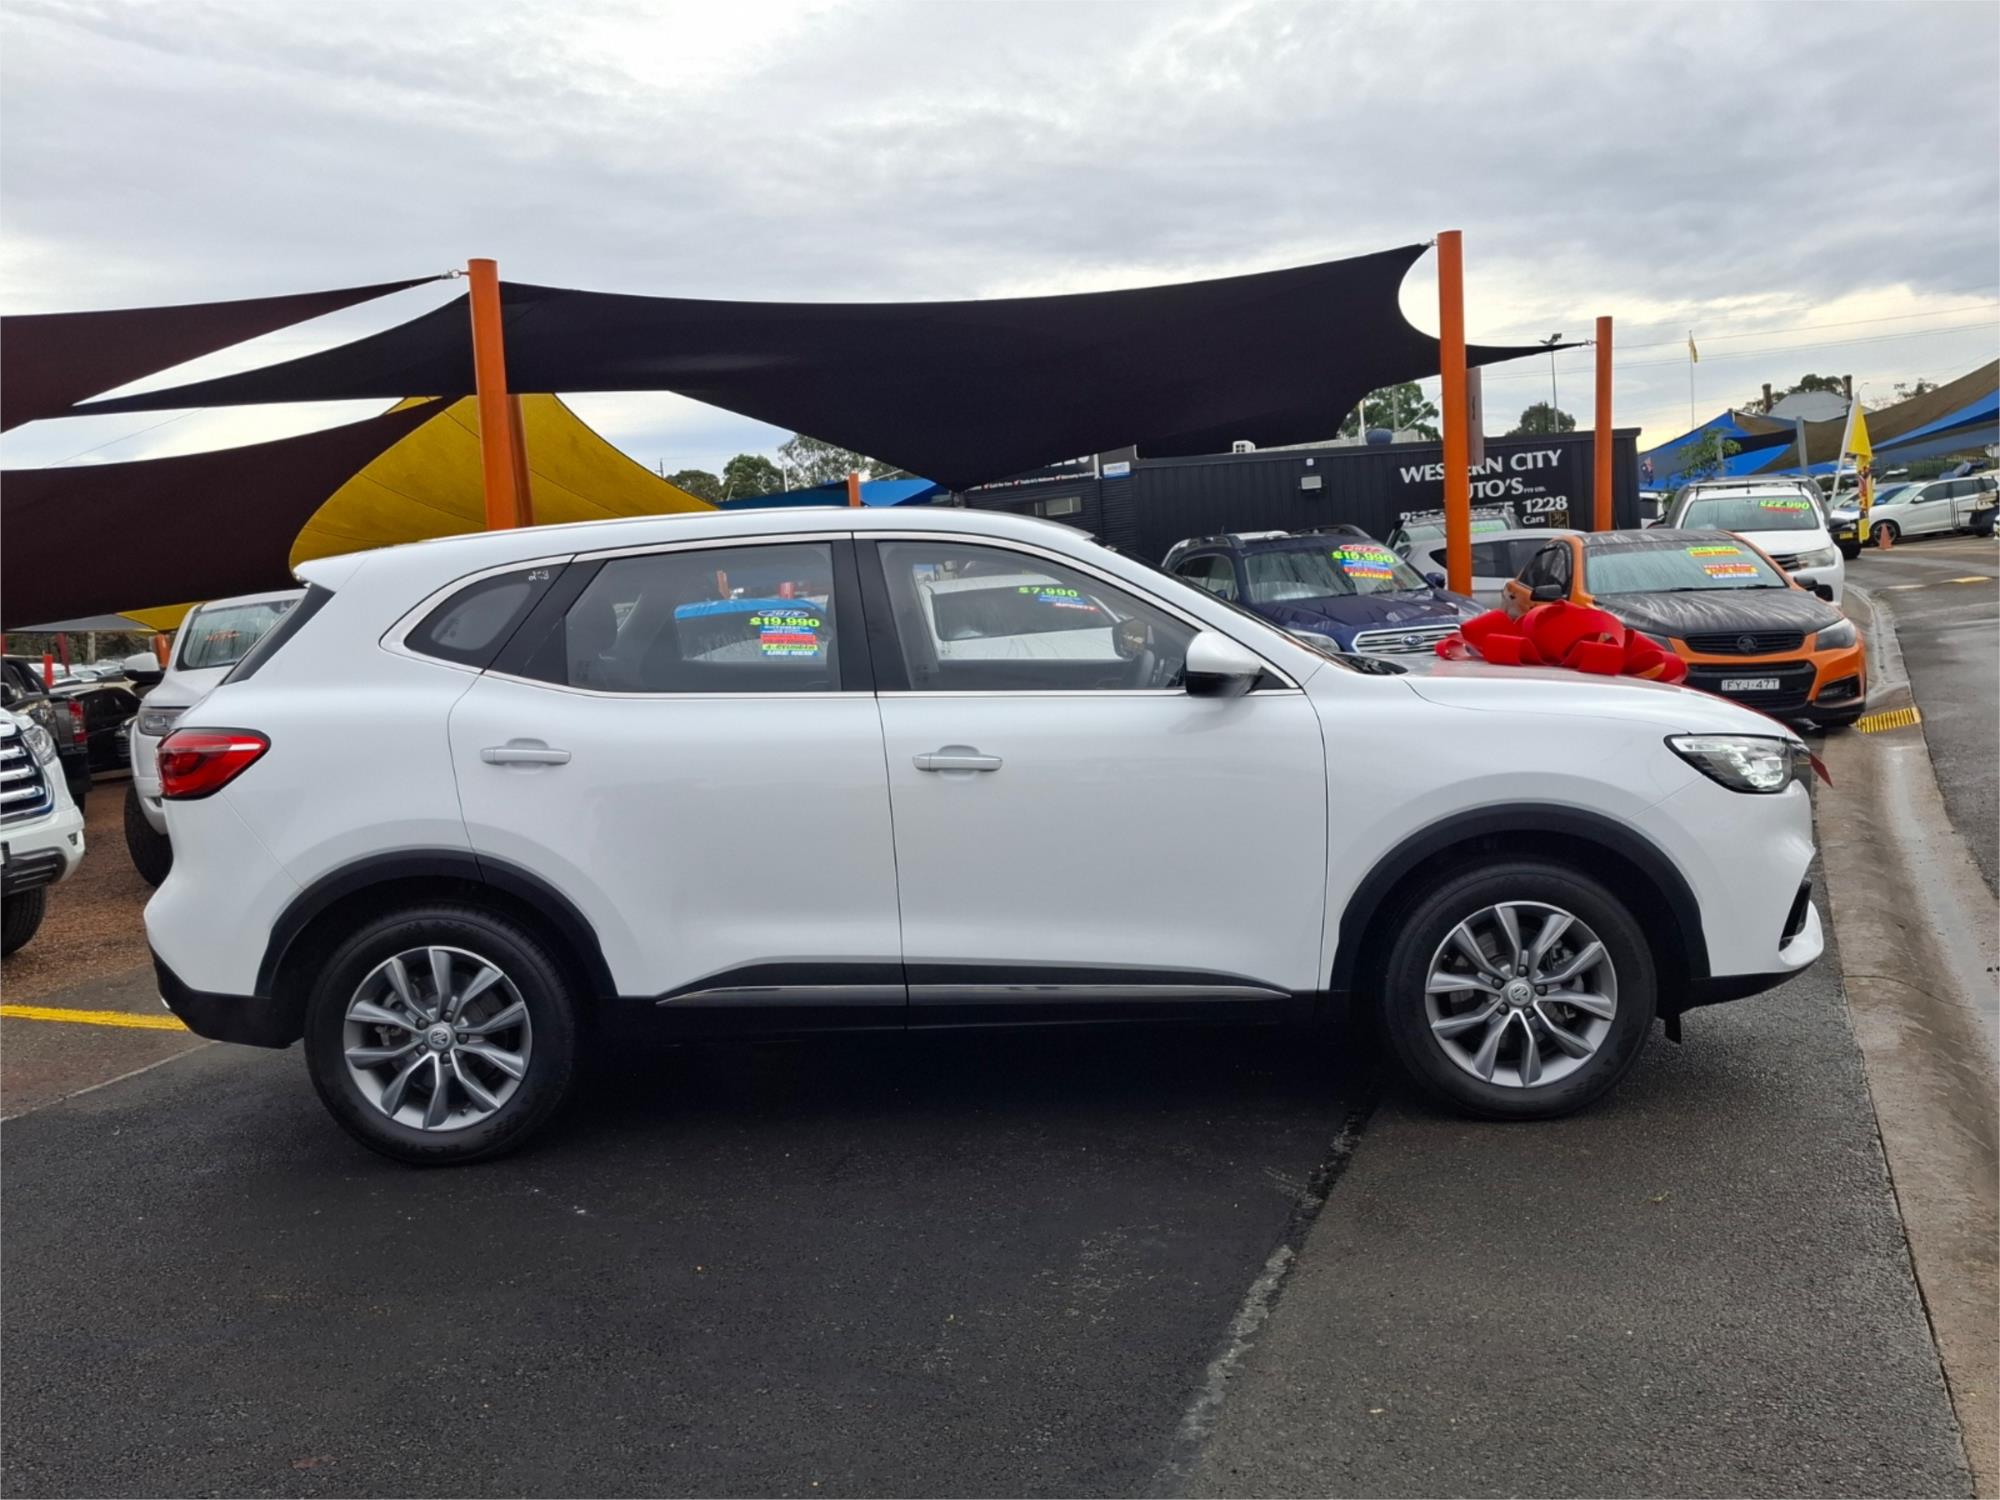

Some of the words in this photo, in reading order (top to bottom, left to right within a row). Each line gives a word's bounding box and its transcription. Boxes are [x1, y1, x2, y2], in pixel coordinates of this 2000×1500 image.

[1400, 456, 1503, 484] WESRN
[1510, 449, 1562, 472] CITY
[1522, 495, 1568, 513] 1228
[1522, 515, 1545, 525] Cars
